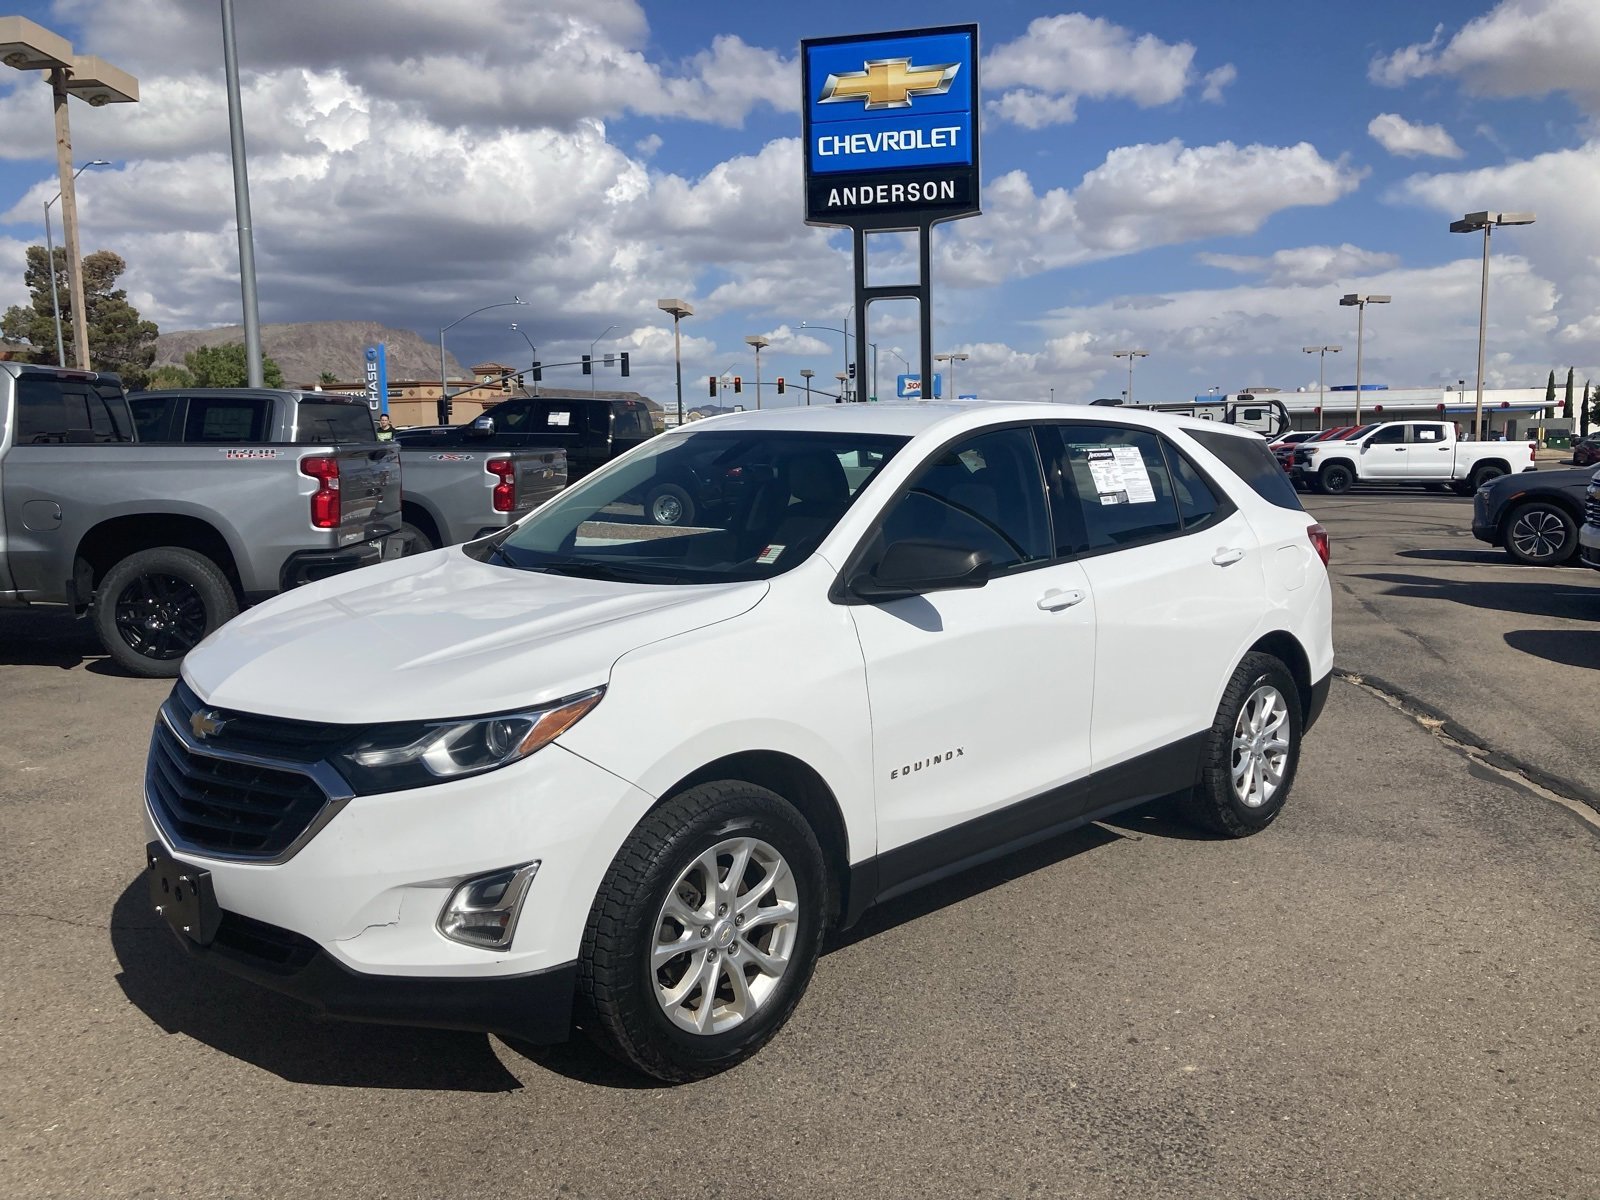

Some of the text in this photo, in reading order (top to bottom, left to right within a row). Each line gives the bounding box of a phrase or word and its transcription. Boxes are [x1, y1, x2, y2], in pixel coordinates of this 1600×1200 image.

[818, 126, 961, 156] CHEVROLET
[827, 180, 955, 207] ANDERSON
[367, 362, 379, 411] CHASE
[890, 746, 964, 780] EQUINOX
